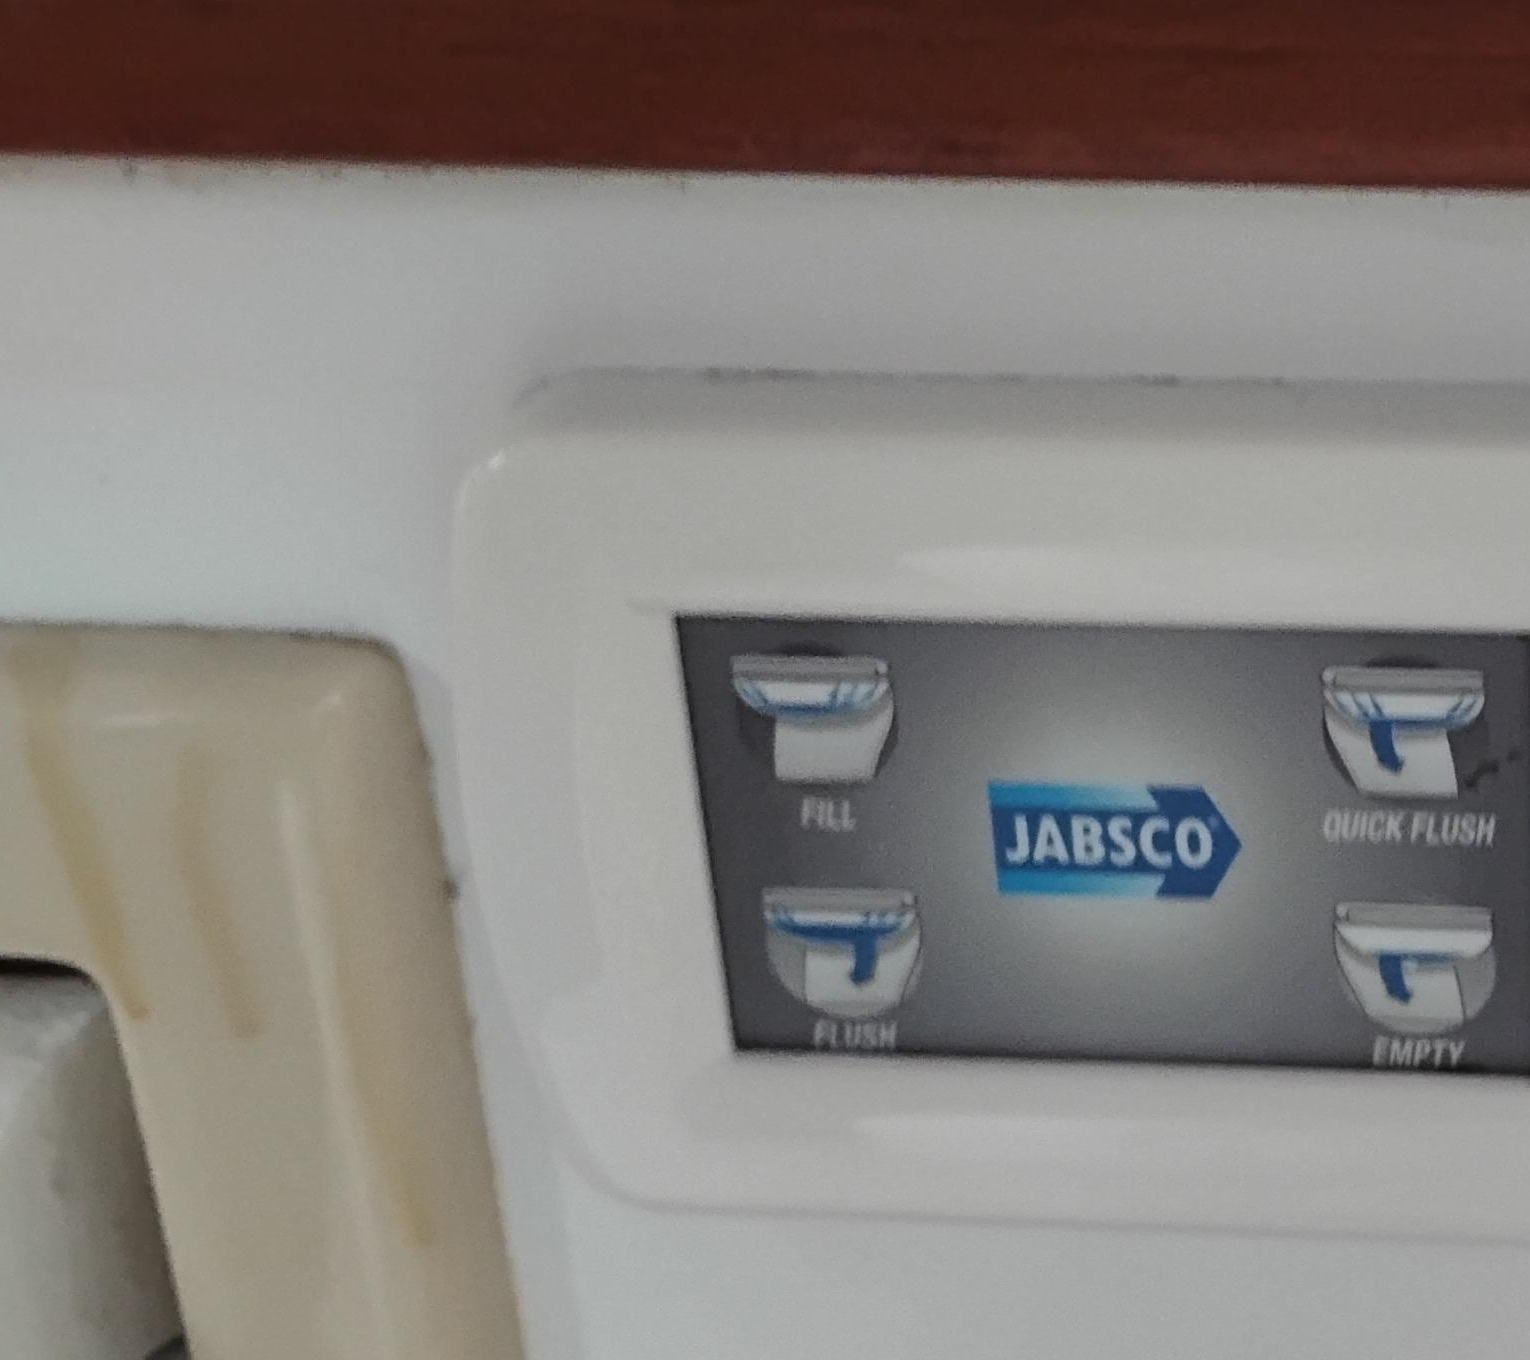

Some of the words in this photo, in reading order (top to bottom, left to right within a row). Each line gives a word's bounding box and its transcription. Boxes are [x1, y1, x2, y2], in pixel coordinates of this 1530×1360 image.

[799, 797, 857, 831] FILL
[1323, 808, 1403, 843] QUICK
[1409, 810, 1496, 848] FLUSH
[1005, 813, 1213, 870] JABSCO
[813, 1020, 897, 1051] FLUSH
[1372, 1036, 1466, 1067] EMPTY
